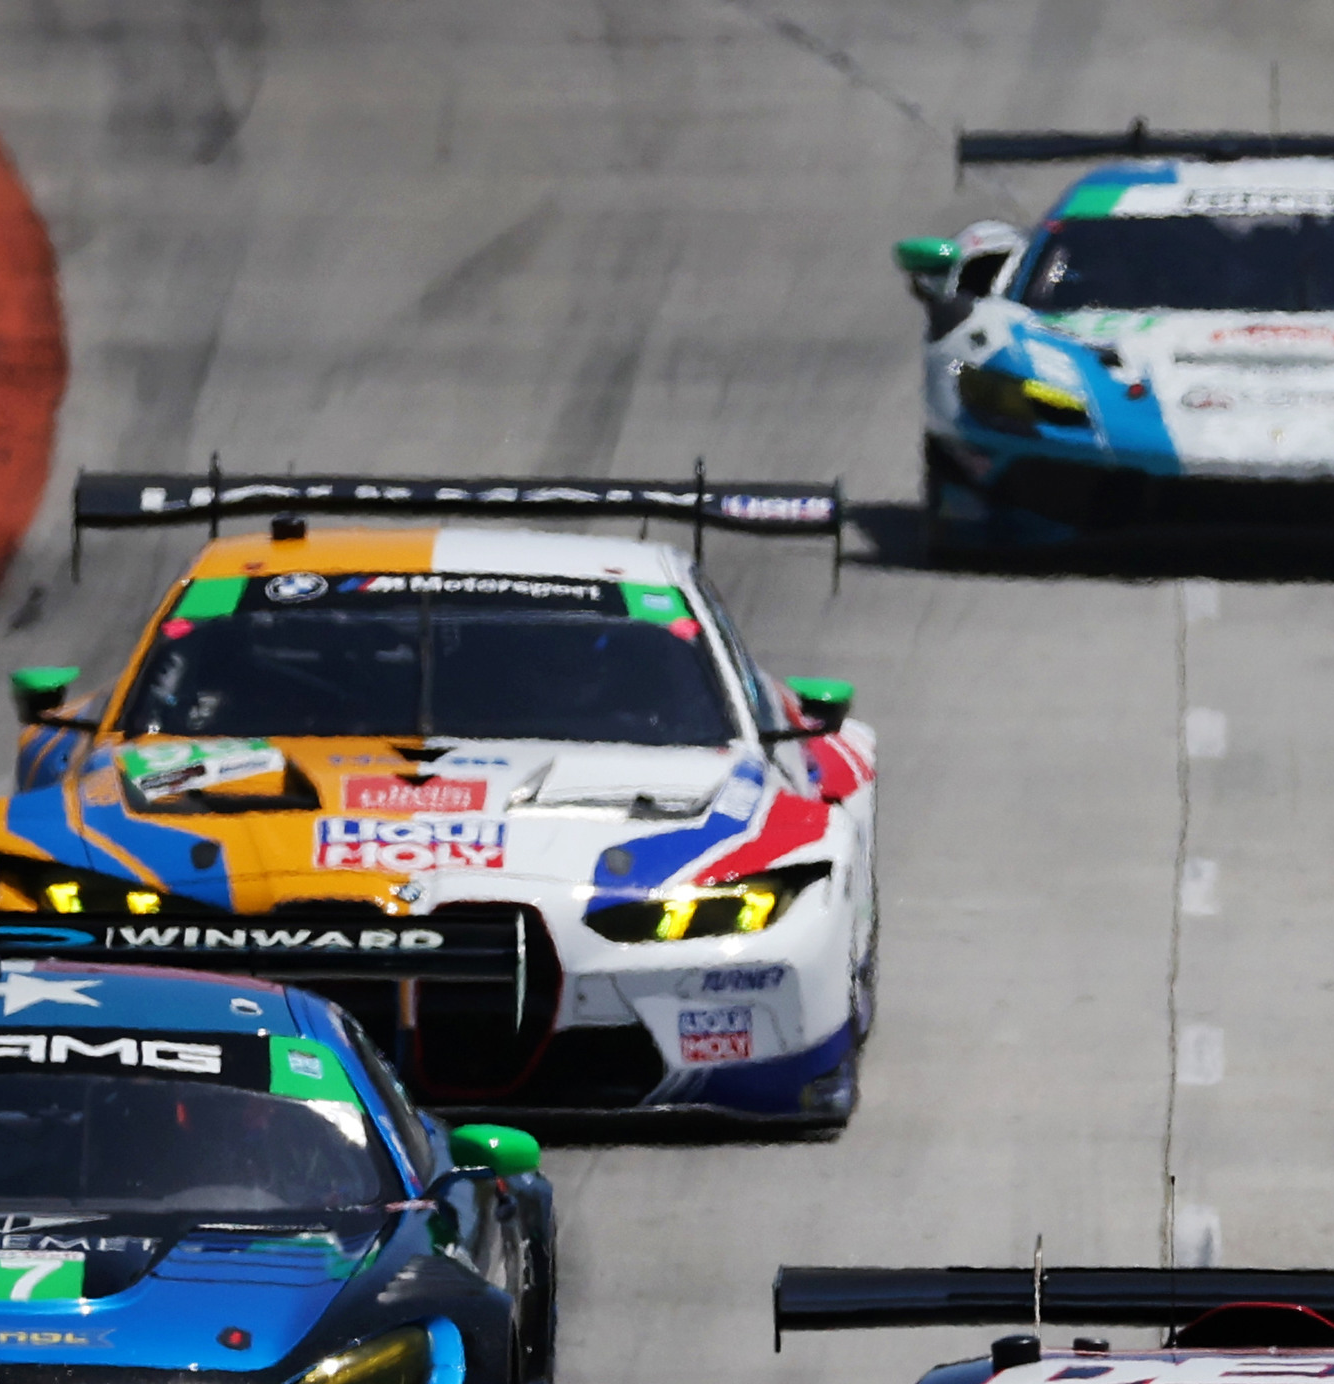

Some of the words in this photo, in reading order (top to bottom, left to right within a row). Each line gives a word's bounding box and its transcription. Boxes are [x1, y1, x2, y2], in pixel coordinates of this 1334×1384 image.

[410, 575, 603, 601] Motorsport
[328, 819, 504, 844] LIQUI
[325, 843, 503, 870] MOLY
[122, 927, 444, 950] WINWARD
